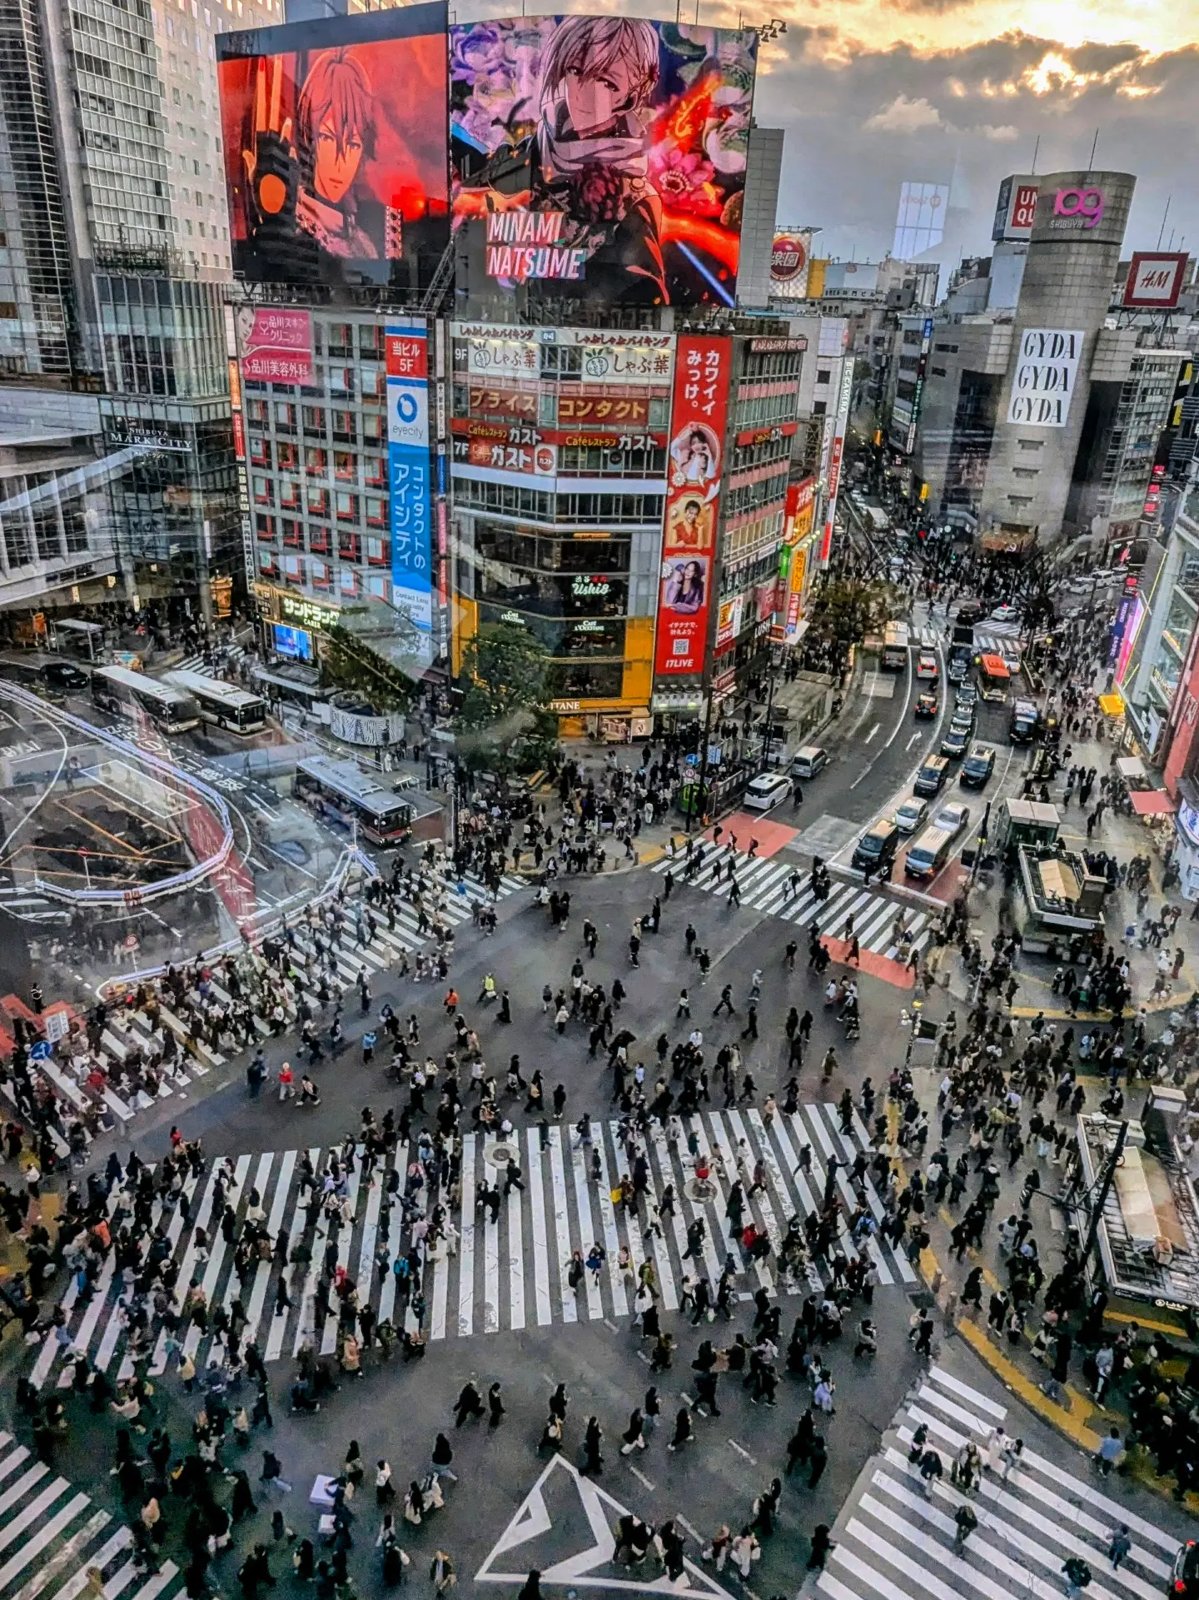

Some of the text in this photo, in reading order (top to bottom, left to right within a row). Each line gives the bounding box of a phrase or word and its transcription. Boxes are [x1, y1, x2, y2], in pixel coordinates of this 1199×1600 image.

[1054, 187, 1105, 229] 109
[489, 212, 564, 243] MINAMI
[1049, 219, 1083, 230] SHIBUYA
[488, 247, 583, 278] NATSUME
[1140, 270, 1171, 289] H&M
[460, 325, 535, 340] しゃぶしゃぶバイキング
[575, 332, 671, 347] しゃぶしゃぶバイキング
[392, 341, 420, 357] 当ビル
[454, 348, 468, 361] 9F
[1024, 332, 1076, 359] GYDA
[400, 358, 414, 372] 5F
[494, 346, 537, 368] しゃぶ葉
[614, 354, 670, 374] しゃぶ葉
[251, 359, 309, 377] 品川美容外科
[1018, 365, 1069, 391] GYDA
[685, 350, 702, 408] みっけ。
[702, 350, 720, 416] カワイイ
[470, 390, 537, 412] プライス
[559, 400, 646, 419] コンタクト
[1012, 397, 1063, 423] GYDA
[110, 433, 192, 448] MARK CITY
[129, 427, 169, 437] SHIBUYA
[393, 424, 424, 440] eyecity
[509, 426, 542, 446] ガスト
[618, 433, 658, 451] ガスト
[454, 441, 469, 456] 7F
[491, 445, 532, 469] ガスト
[393, 463, 412, 567] アイシティ
[413, 466, 426, 570] コンタクトの
[284, 598, 340, 626] サンドラッグ
[665, 659, 694, 668] 17LIVE
